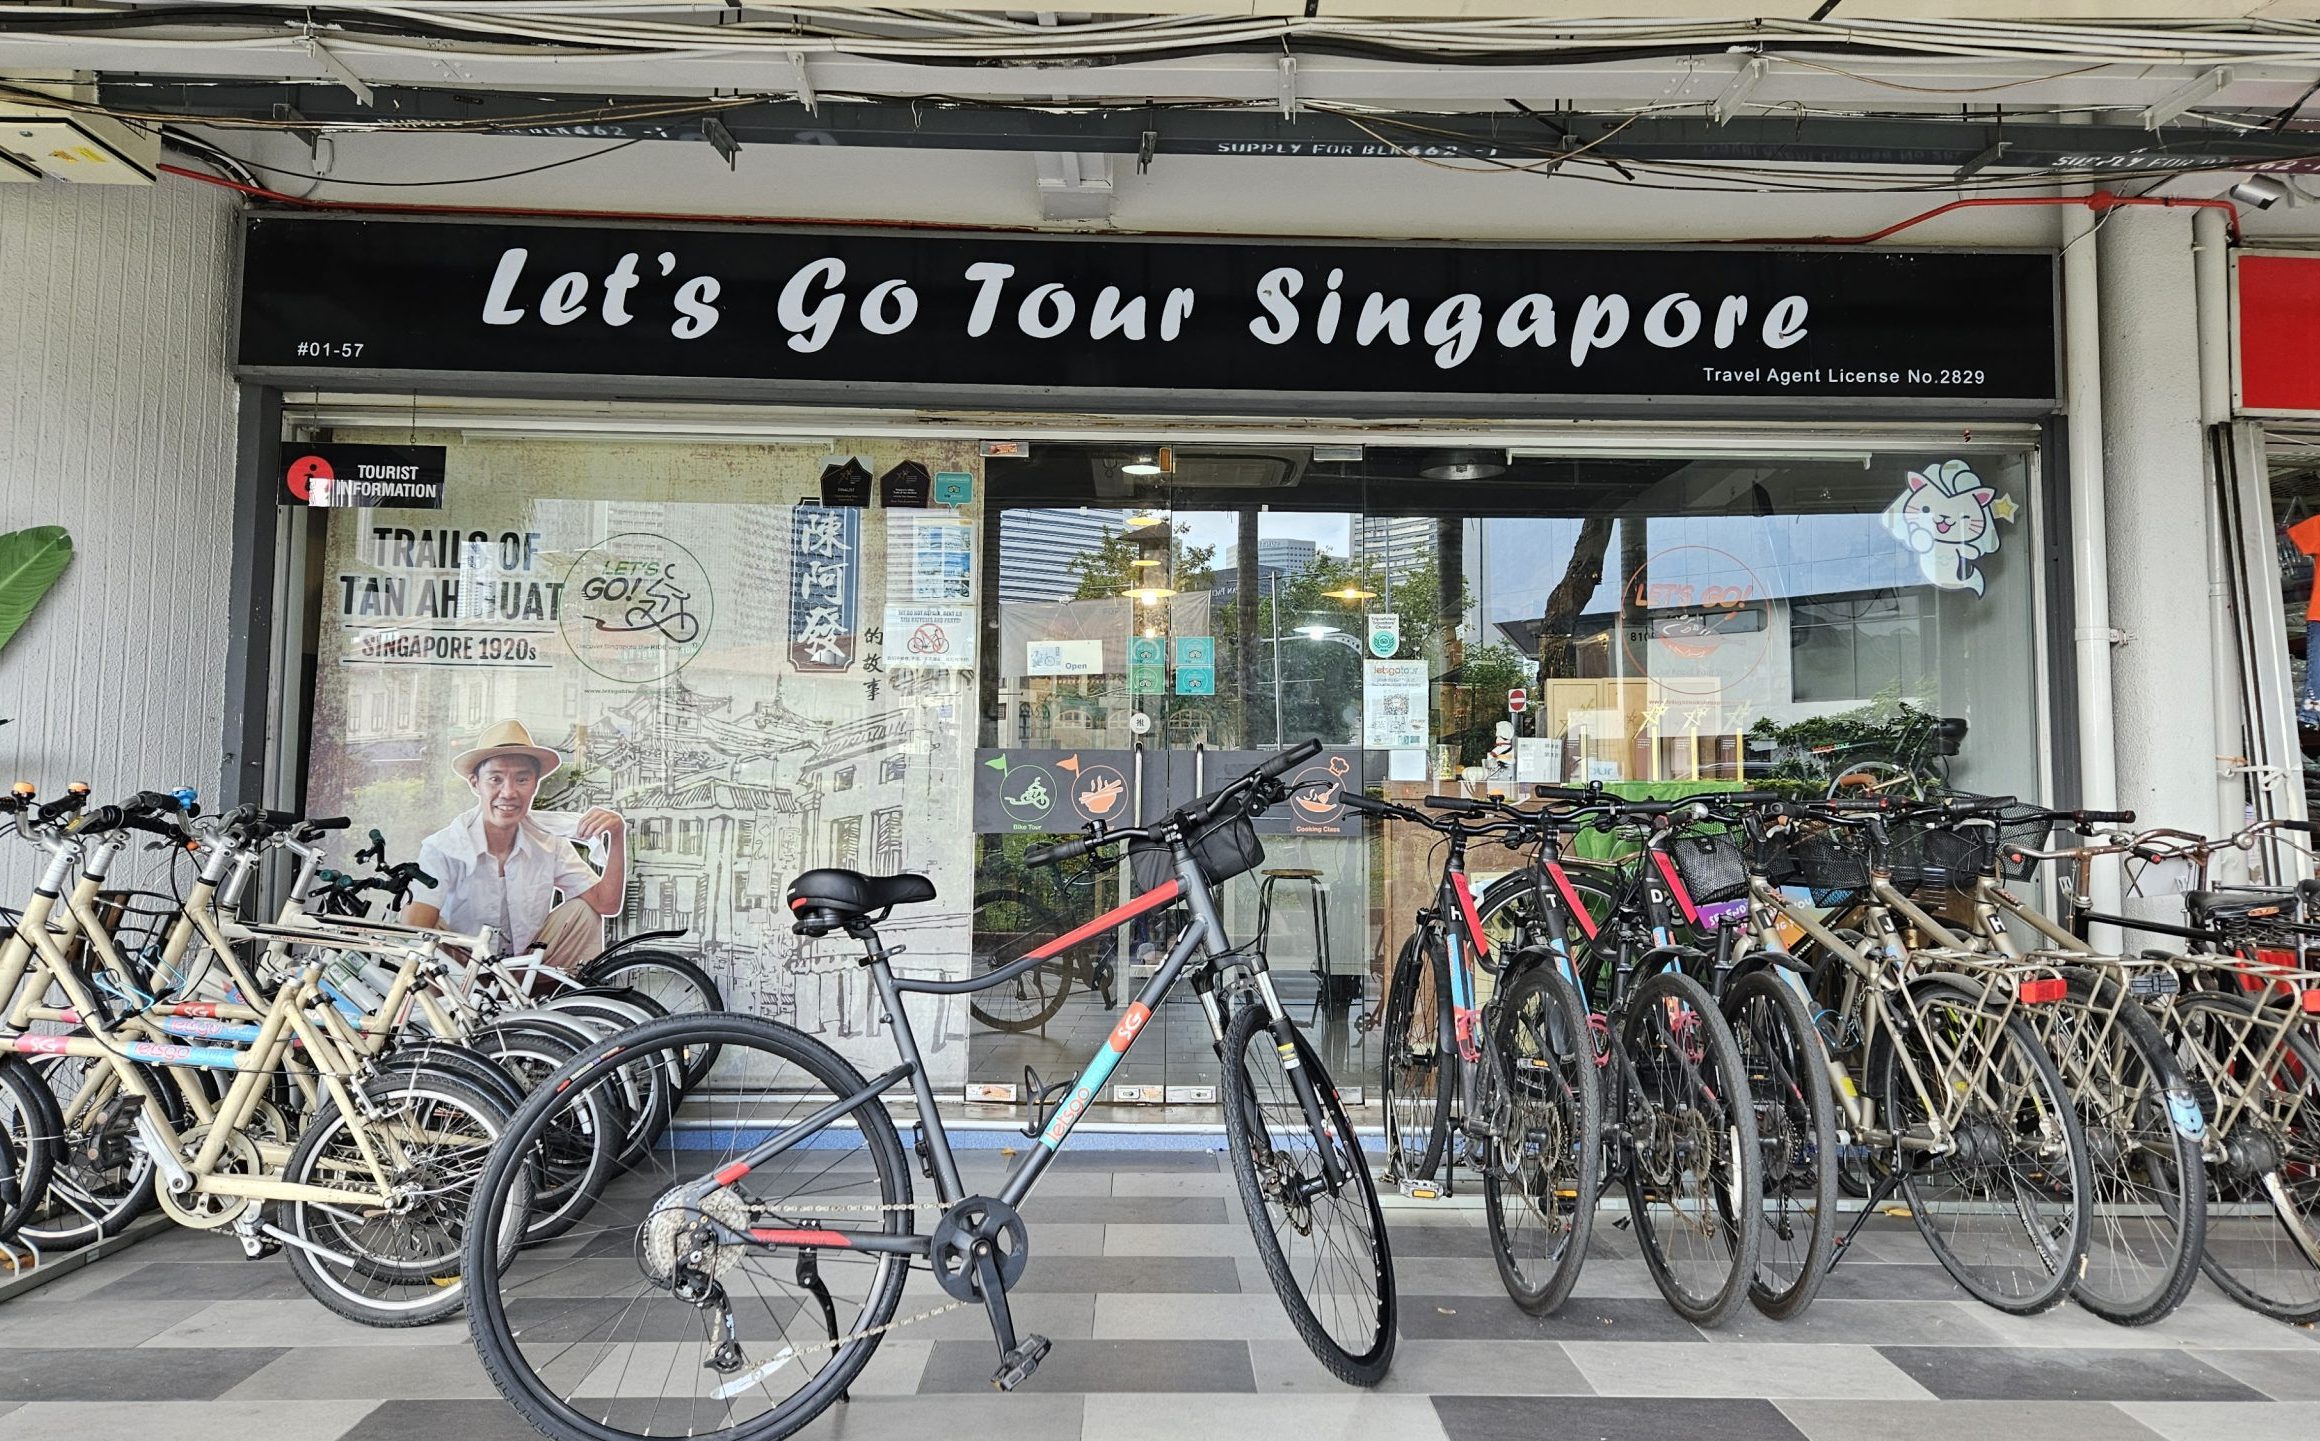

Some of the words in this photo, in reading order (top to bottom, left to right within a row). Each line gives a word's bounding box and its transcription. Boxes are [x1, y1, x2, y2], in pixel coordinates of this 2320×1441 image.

[1218, 143, 1301, 153] SUPPLY
[1312, 144, 1352, 154] FOR
[483, 249, 720, 341] Let's
[778, 258, 918, 352] Go
[965, 263, 1195, 342] Tour
[1250, 268, 1810, 369] Singapore
[298, 342, 365, 357] #01-57
[1703, 368, 1760, 381] Travel
[1766, 369, 1821, 385] Agent
[1828, 369, 1900, 383] License
[1908, 370, 1985, 384] No.2829
[357, 465, 419, 480] TOURIST
[337, 480, 436, 498] INFORMATION
[373, 527, 487, 571] TRAILS
[499, 532, 541, 571] OF
[602, 561, 660, 576] LET'S
[581, 577, 642, 601] GO!
[797, 509, 853, 658] 陳阿發
[340, 576, 406, 617] TAN
[415, 579, 460, 618] AH
[1636, 583, 1694, 606] LET'S
[1702, 585, 1753, 608] GO!
[362, 634, 473, 659] SINGAPORE
[479, 637, 536, 660] 1920s
[862, 626, 884, 700] 的故事
[1065, 662, 1087, 671] Open
[1546, 893, 1557, 908] T
[1650, 889, 1664, 903] D
[1883, 916, 1895, 932] J
[1989, 916, 2006, 932] H
[184, 1005, 209, 1016] SG
[1117, 1013, 1142, 1039] SG
[31, 1037, 56, 1052] SG
